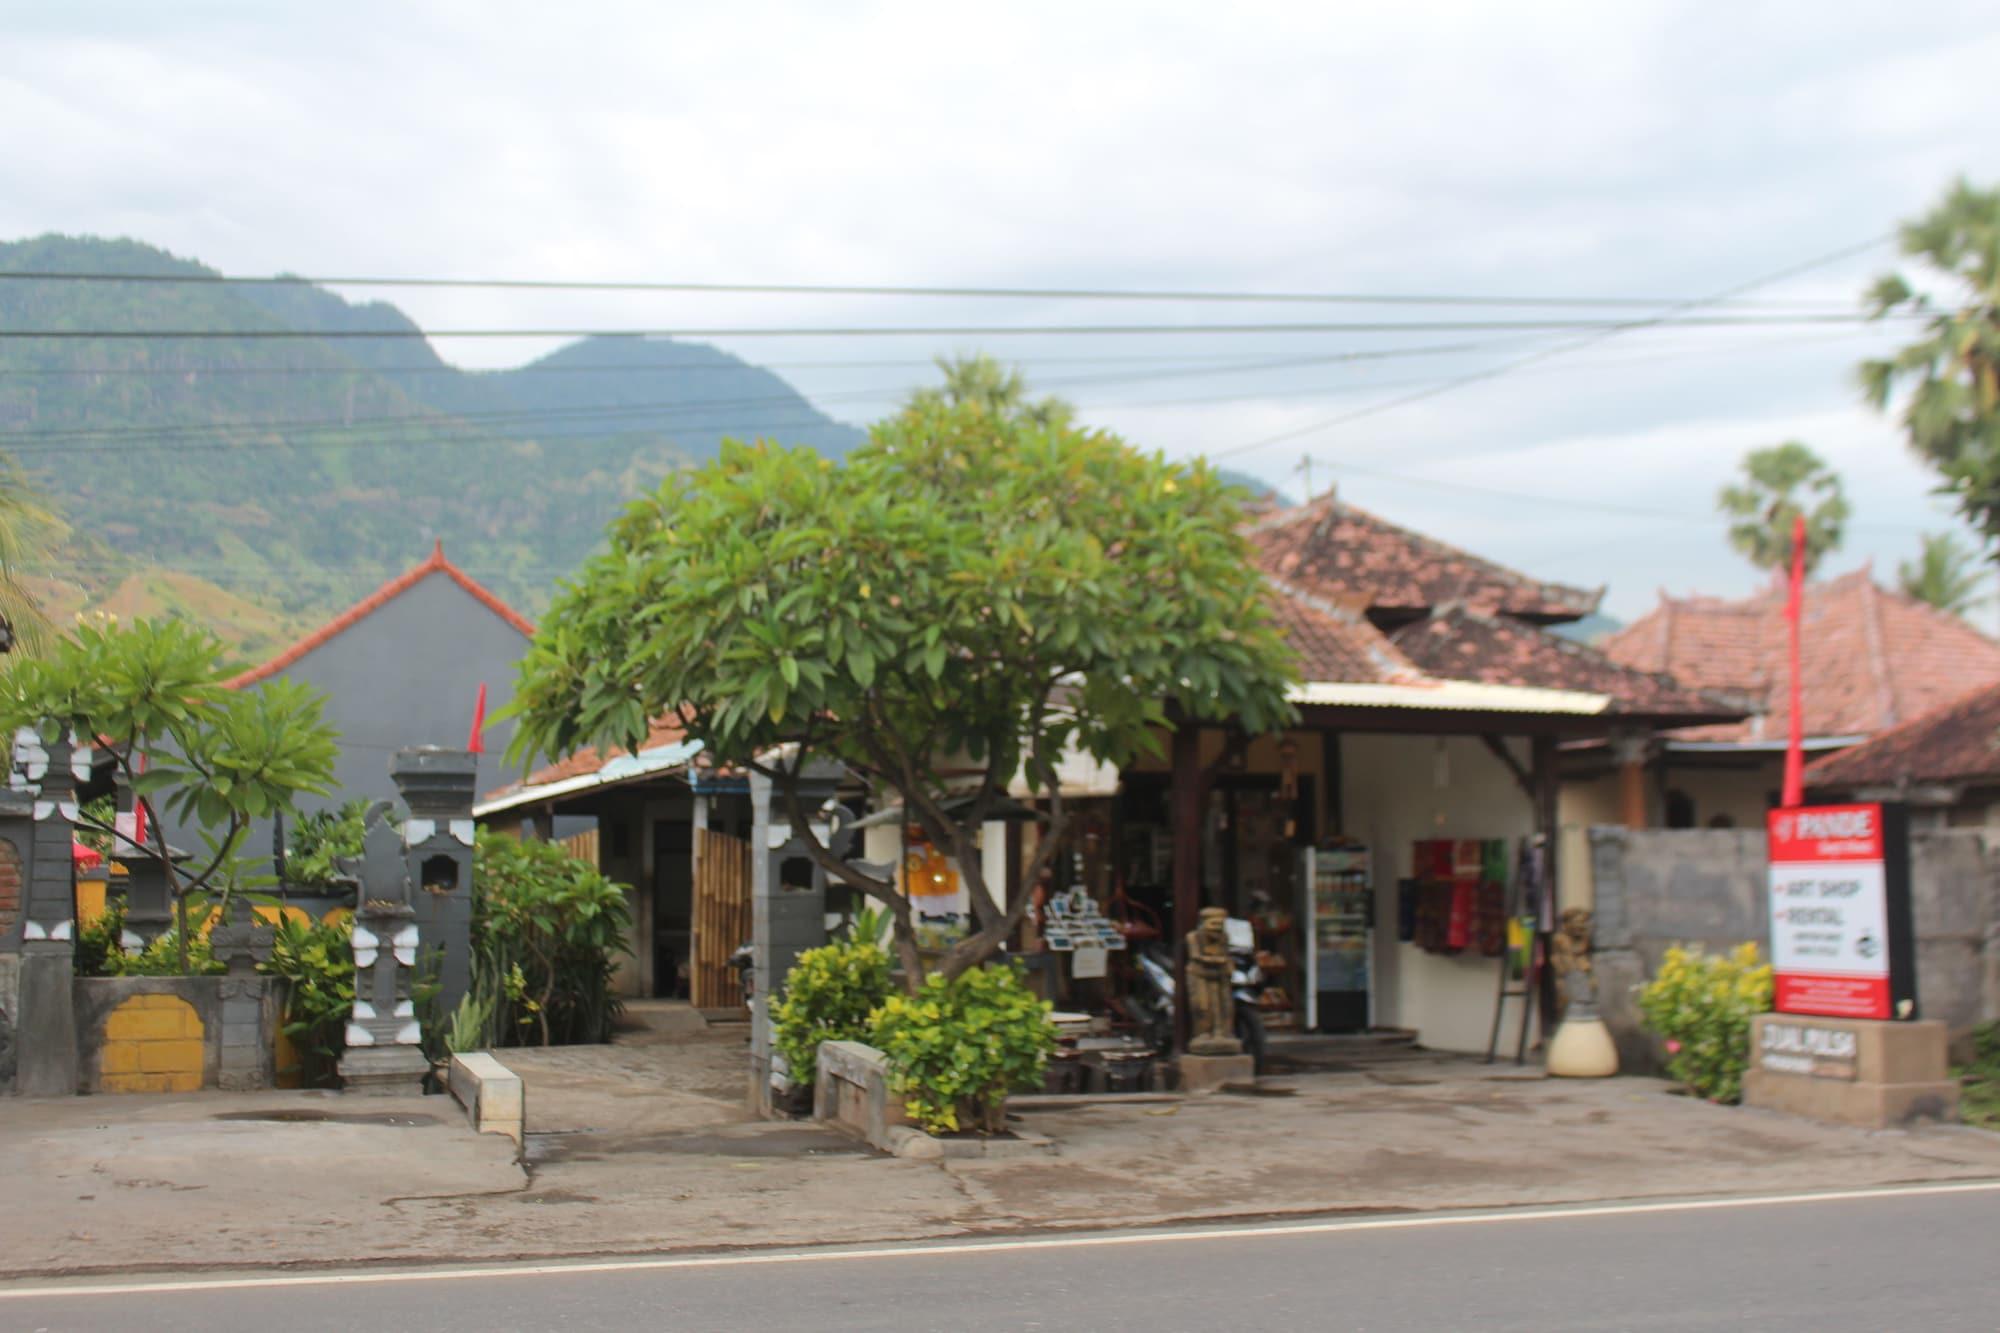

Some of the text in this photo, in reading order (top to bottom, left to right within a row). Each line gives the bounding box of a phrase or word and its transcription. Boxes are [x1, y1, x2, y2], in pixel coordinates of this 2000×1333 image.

[1786, 879, 1861, 899] ART SHOP
[1786, 907, 1844, 927] RENTAL
